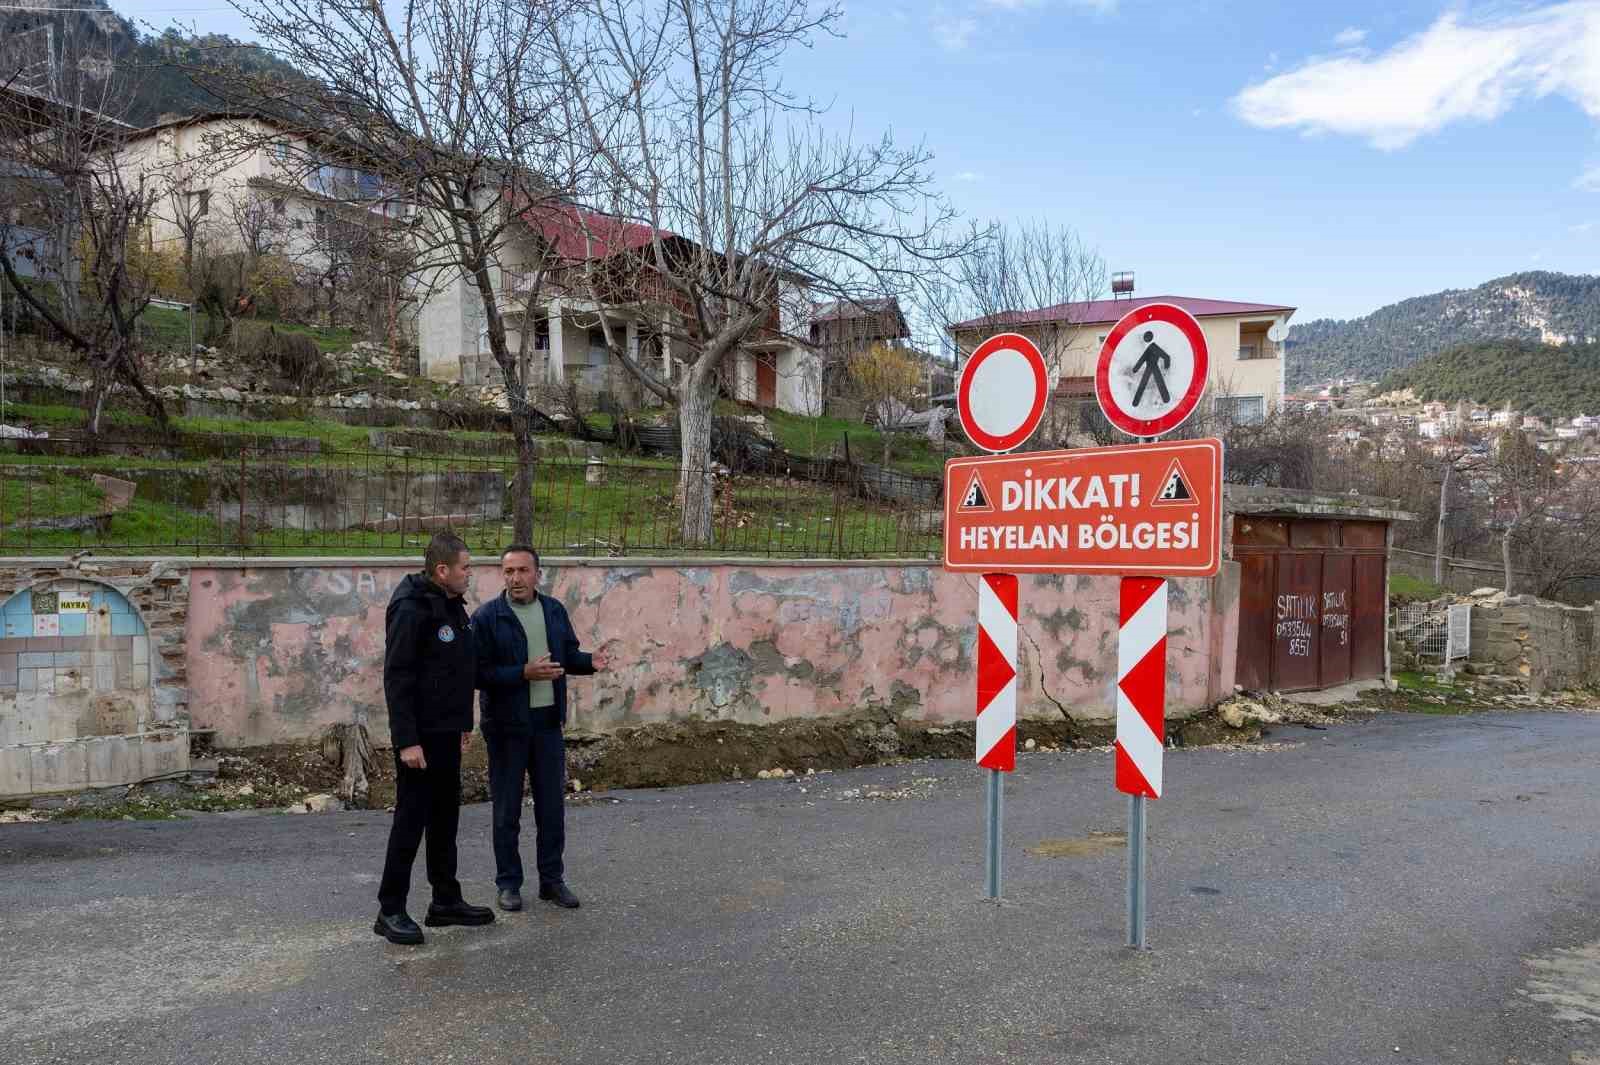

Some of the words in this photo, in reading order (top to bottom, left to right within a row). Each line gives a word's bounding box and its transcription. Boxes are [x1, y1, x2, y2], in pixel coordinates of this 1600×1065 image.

[1001, 468, 1140, 512] DİKKAT!
[959, 524, 1069, 550] HEYELAN
[1078, 512, 1200, 550] BÖLGESİ
